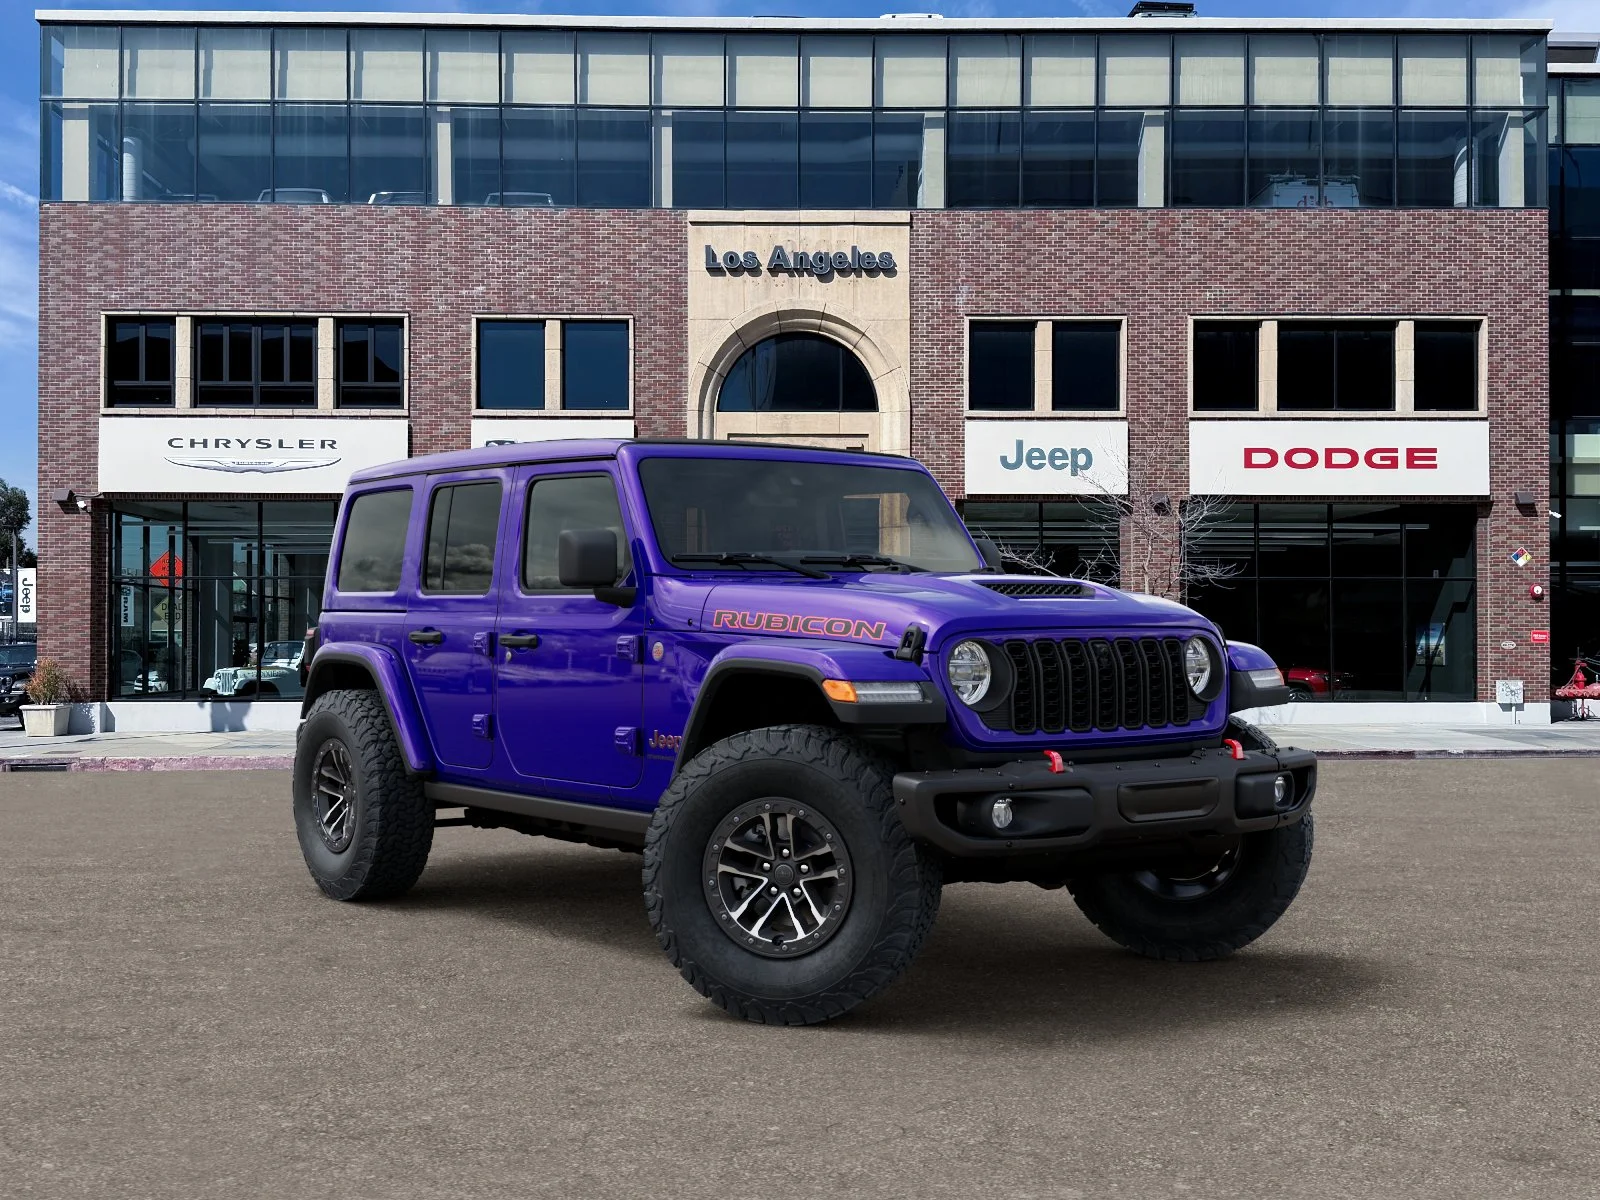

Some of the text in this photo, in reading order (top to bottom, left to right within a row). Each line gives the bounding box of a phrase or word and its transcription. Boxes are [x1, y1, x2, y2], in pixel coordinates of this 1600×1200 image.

[704, 244, 895, 276] Los Angeles
[167, 437, 338, 450] CHRYSLER
[999, 438, 1093, 477] Jeep
[1243, 447, 1438, 470] DODGE
[20, 577, 34, 613] Jeep
[164, 612, 181, 620] ED
[712, 609, 887, 641] RUBICON
